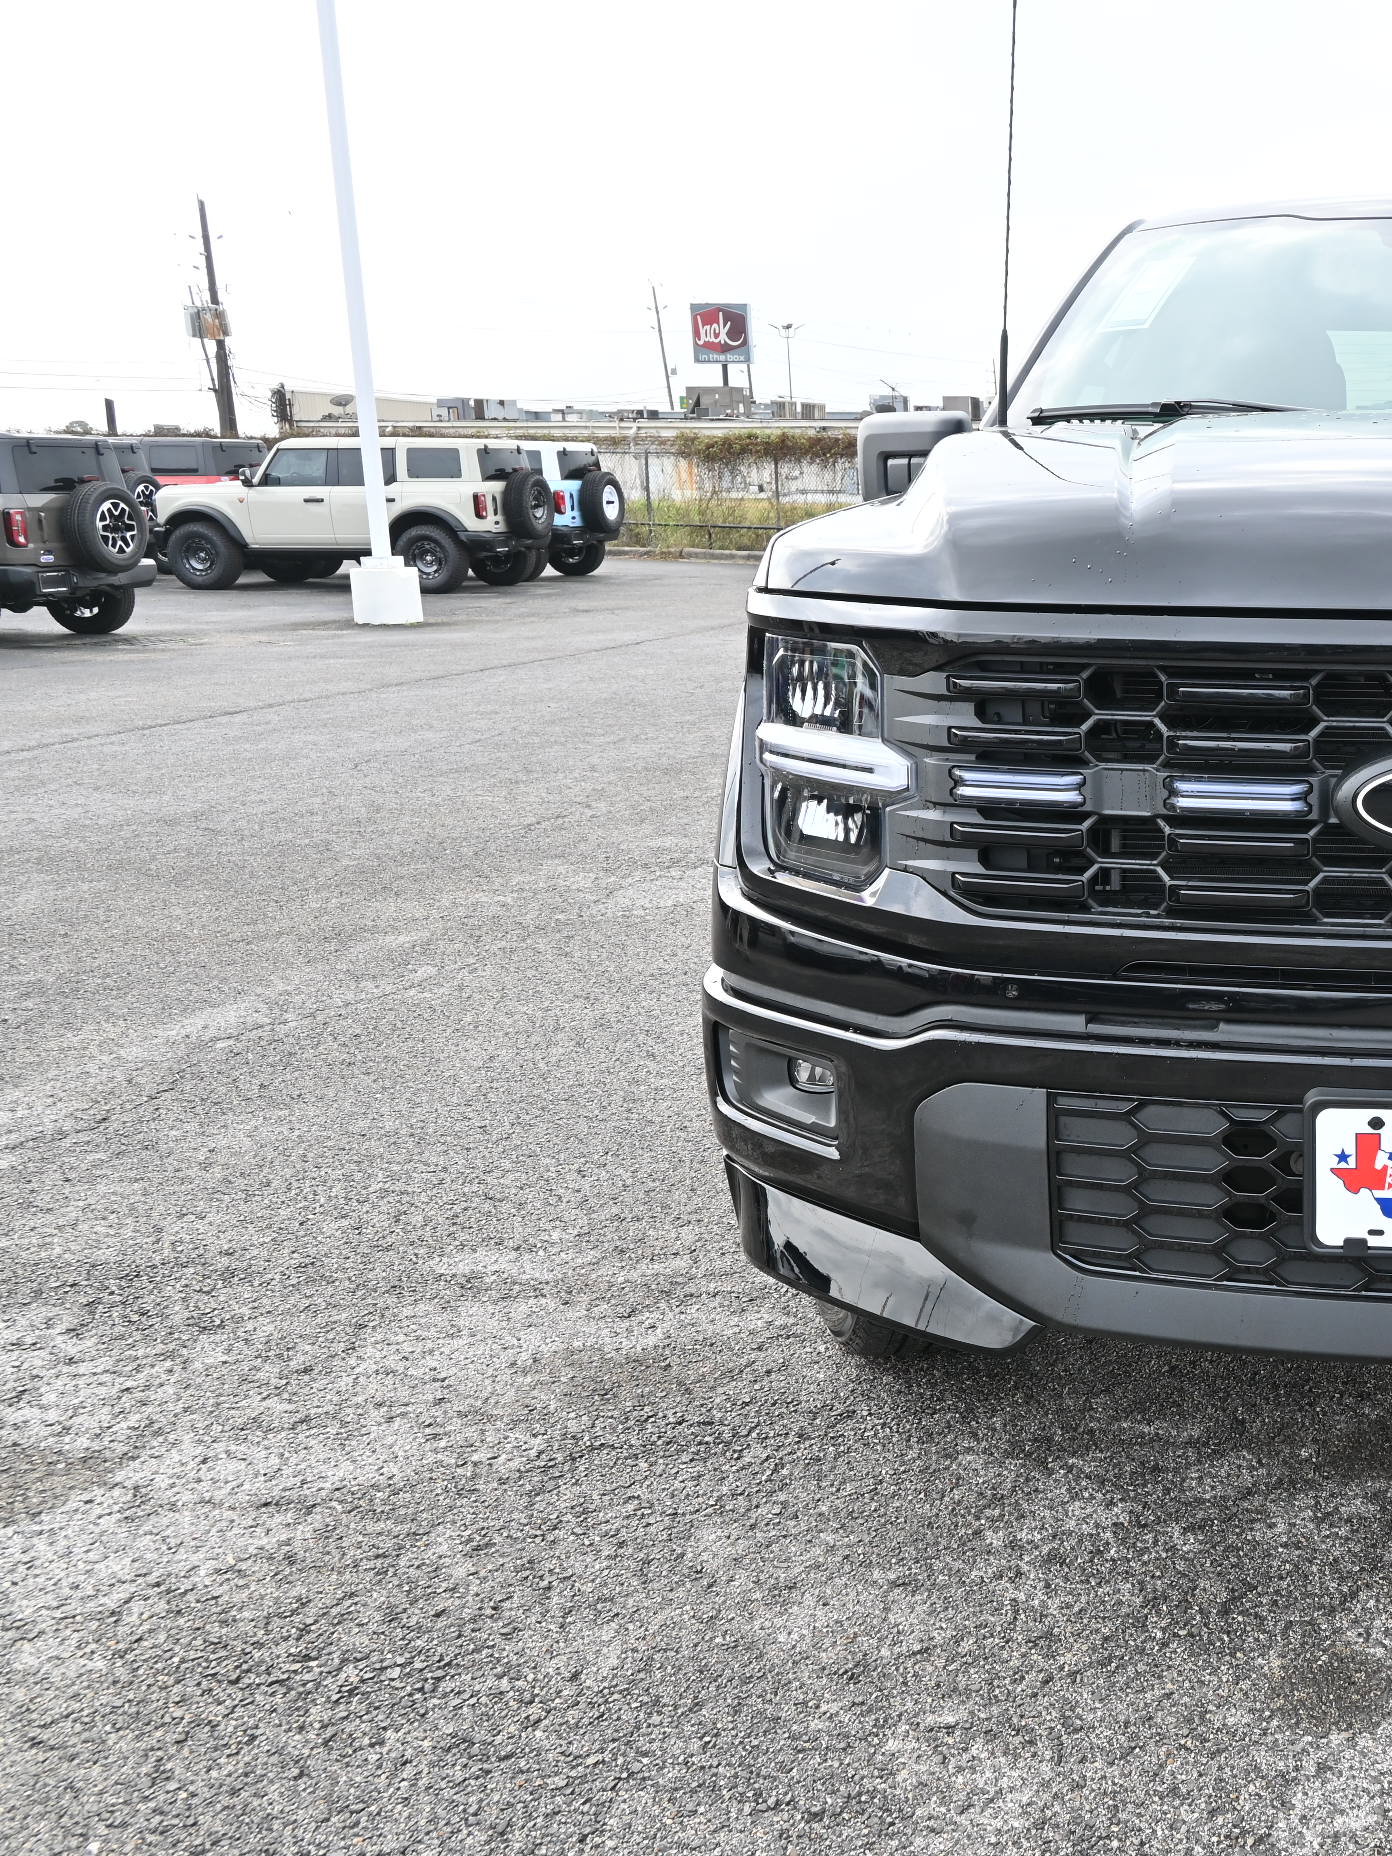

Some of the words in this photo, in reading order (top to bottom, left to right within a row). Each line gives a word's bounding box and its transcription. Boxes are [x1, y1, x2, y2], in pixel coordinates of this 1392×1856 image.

[696, 312, 744, 345] Jack
[700, 353, 708, 361] in
[709, 353, 726, 361] the
[728, 353, 745, 361] box
